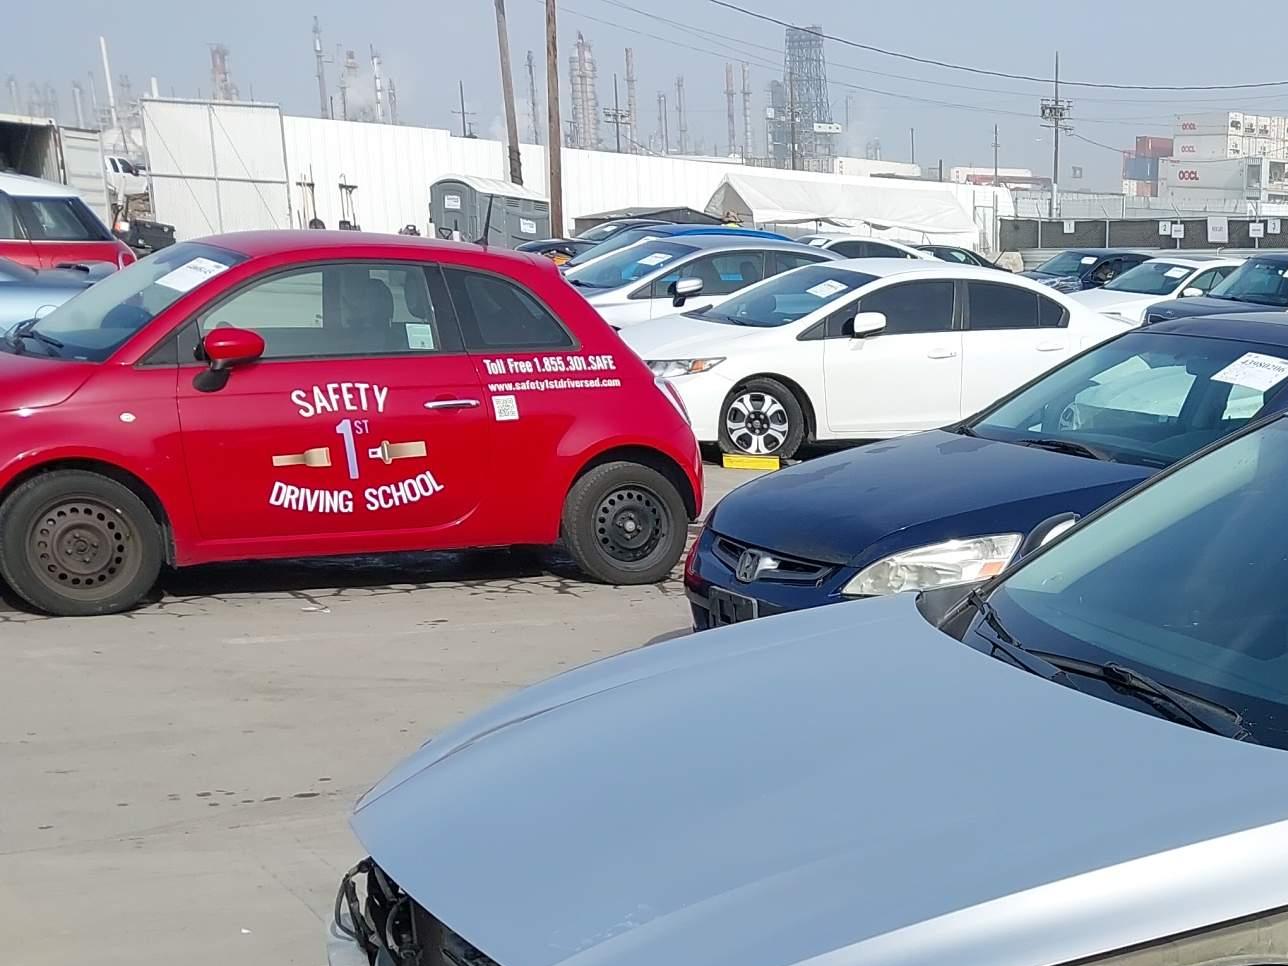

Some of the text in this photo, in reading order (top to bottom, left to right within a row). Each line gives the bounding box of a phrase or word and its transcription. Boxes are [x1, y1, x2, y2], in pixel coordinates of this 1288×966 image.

[1178, 170, 1199, 181] OOCL
[1162, 224, 1167, 232] 2
[483, 355, 616, 375] Toll Free 1.855.301.SAFE
[291, 383, 388, 417] SAFETY
[269, 481, 353, 513] DRIVING
[364, 471, 444, 511] SCHOOL
